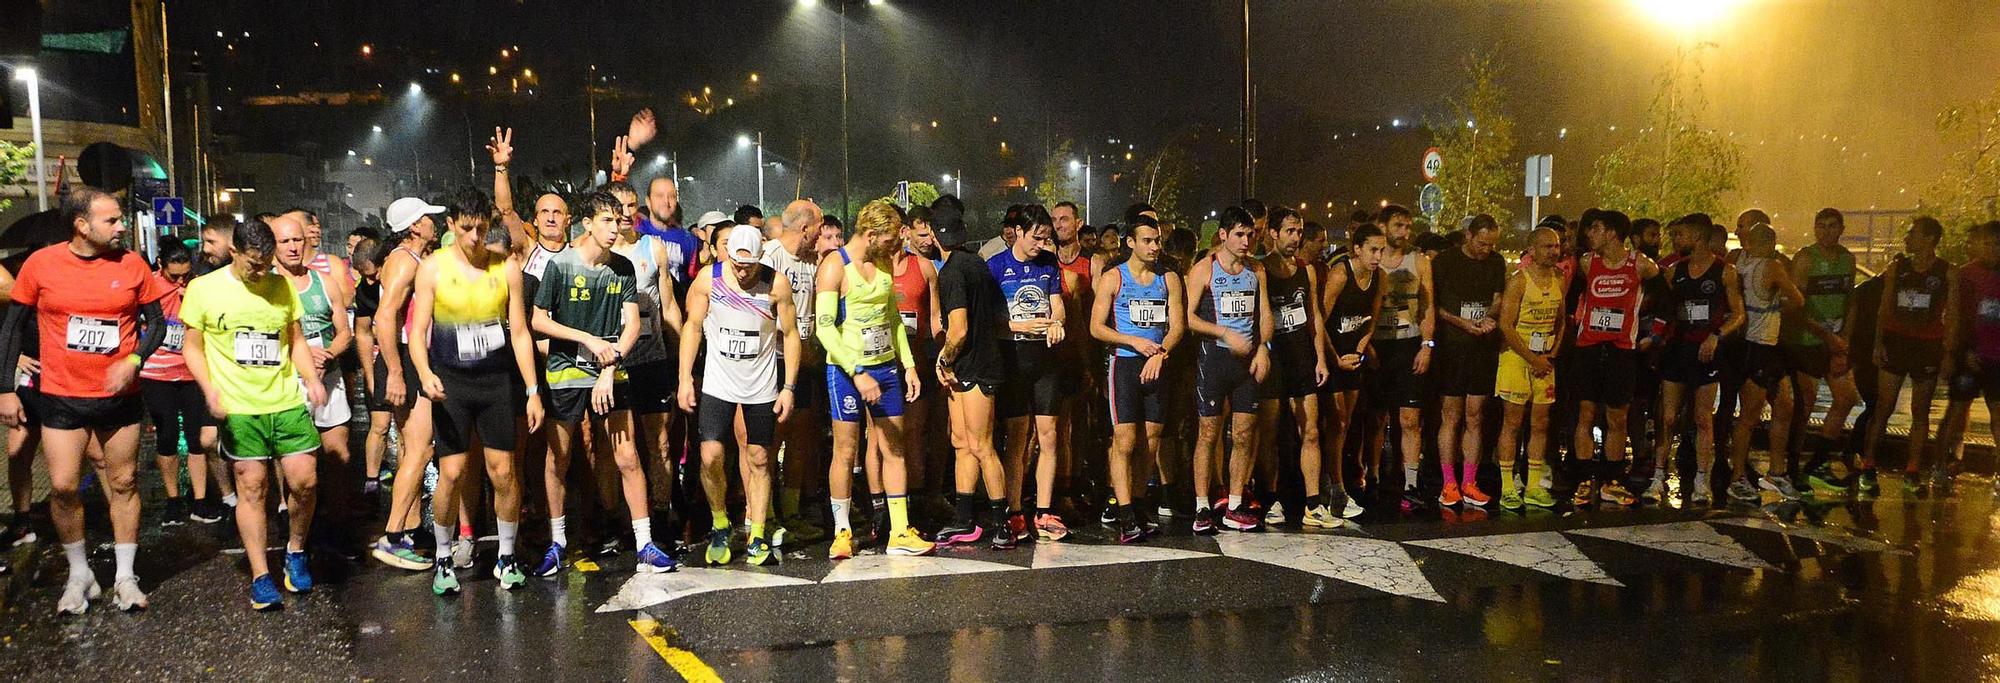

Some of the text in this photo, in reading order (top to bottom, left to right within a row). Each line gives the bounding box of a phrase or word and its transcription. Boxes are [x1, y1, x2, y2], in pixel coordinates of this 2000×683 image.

[1231, 300, 1246, 312] 105
[1139, 309, 1155, 321] 104
[1599, 315, 1610, 326] 48
[79, 329, 105, 346] 207
[251, 344, 267, 359] 131
[728, 339, 746, 353] 170
